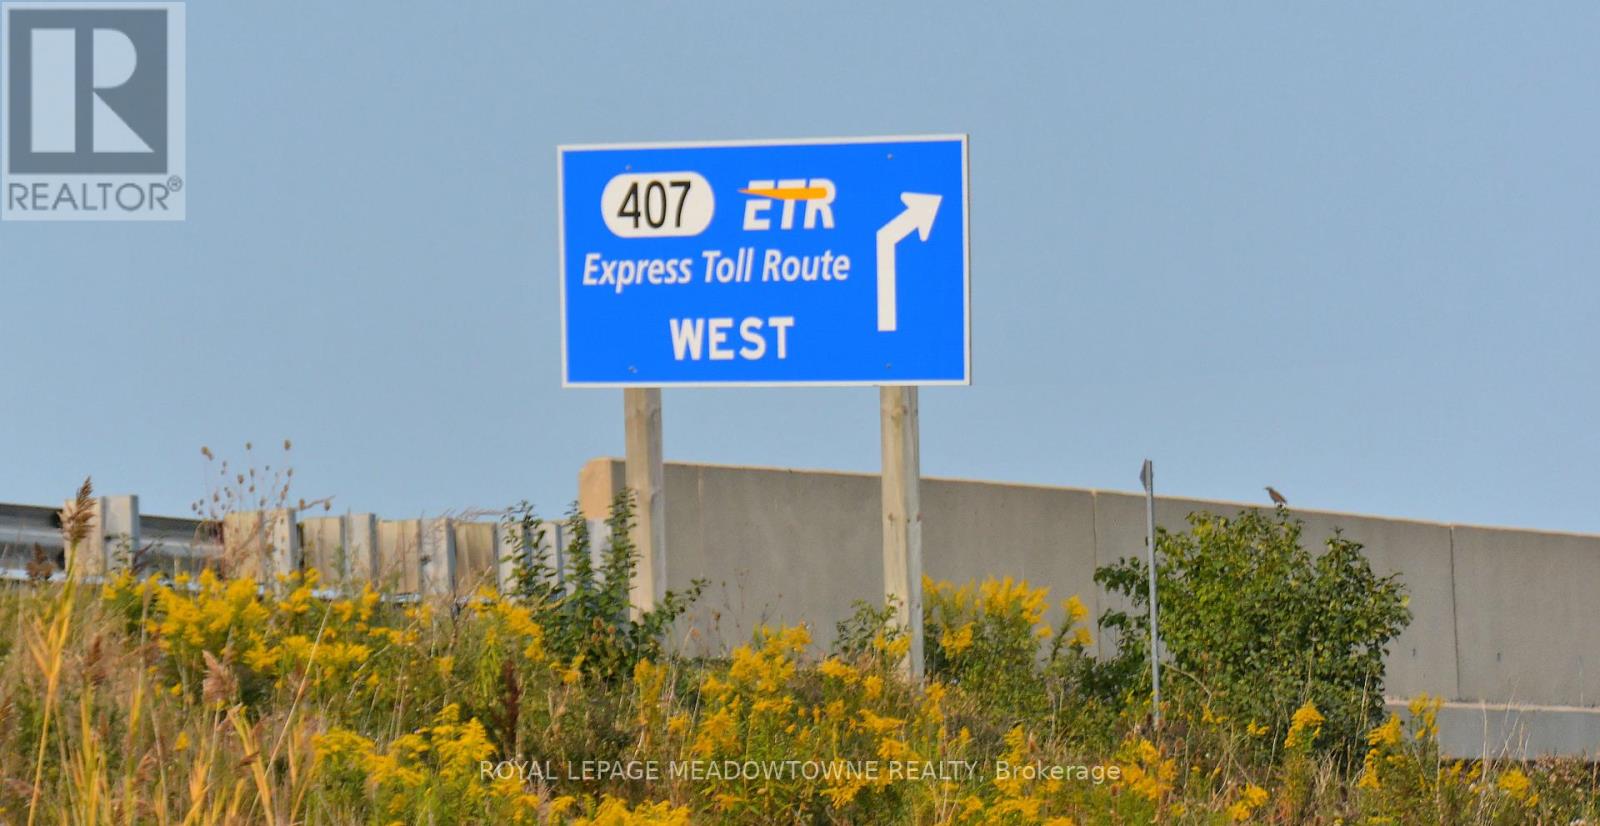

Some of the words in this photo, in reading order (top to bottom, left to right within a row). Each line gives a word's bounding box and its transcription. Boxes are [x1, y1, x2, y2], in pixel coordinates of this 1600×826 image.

[617, 180, 691, 229] 407
[742, 178, 837, 231] ETR
[582, 252, 692, 293] Express
[702, 247, 754, 283] Toll
[762, 249, 851, 282] Route
[669, 316, 794, 361] WEST
